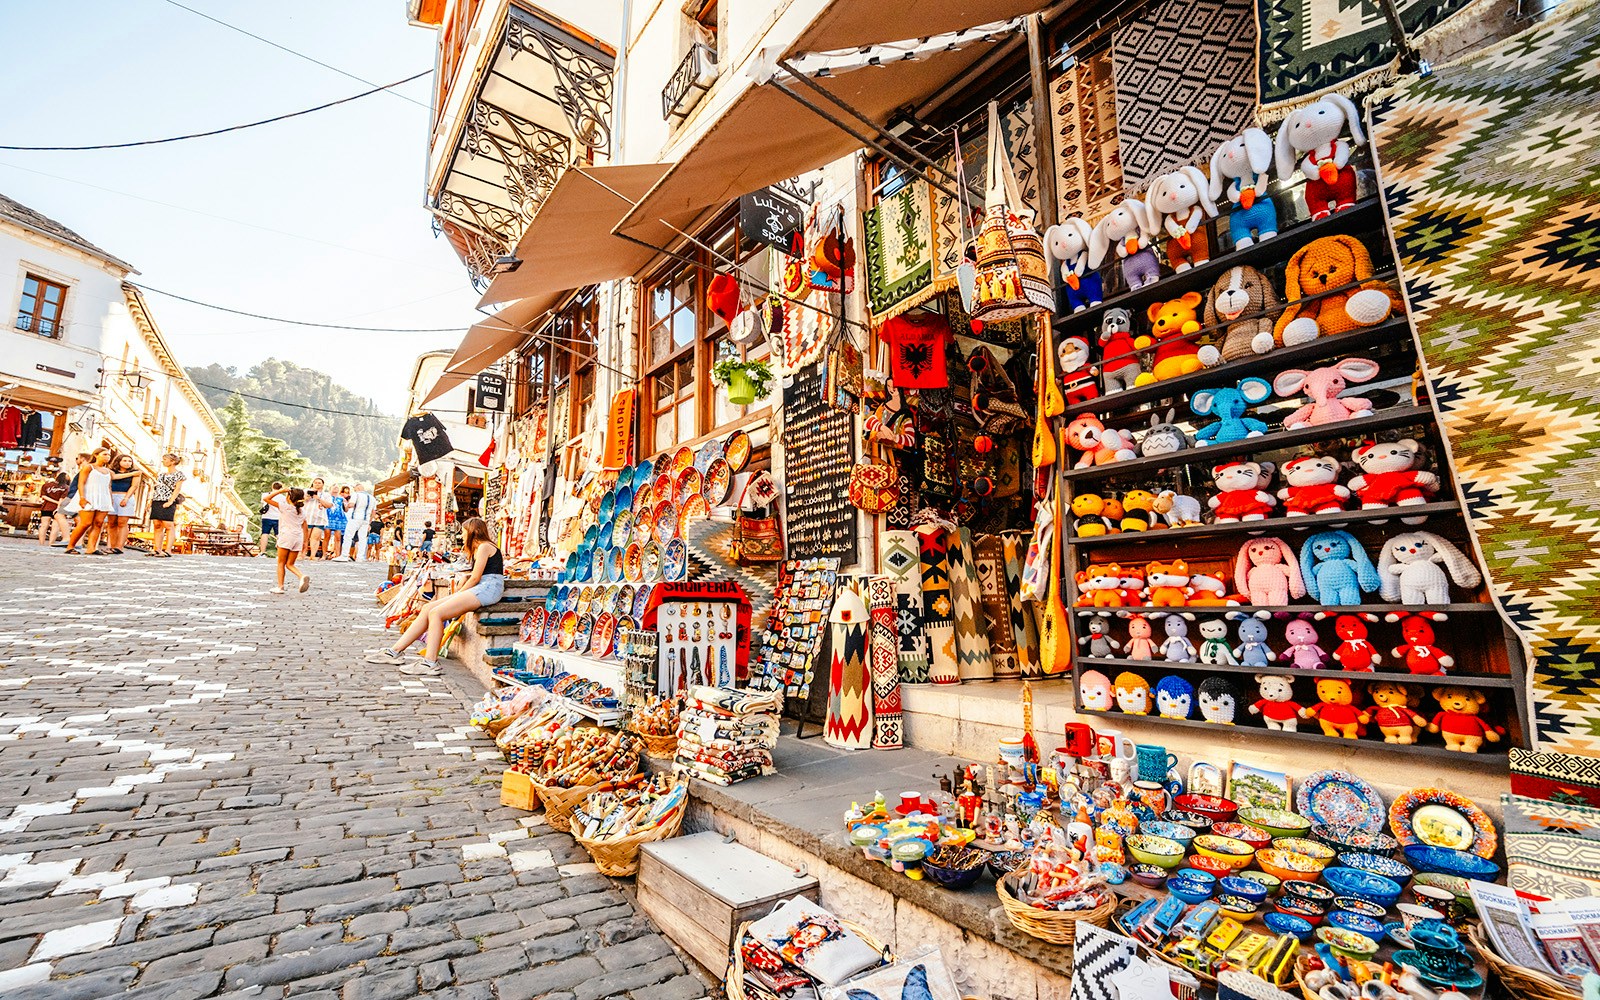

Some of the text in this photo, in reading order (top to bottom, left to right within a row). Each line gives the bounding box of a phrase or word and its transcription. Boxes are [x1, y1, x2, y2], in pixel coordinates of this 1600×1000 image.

[753, 196, 795, 223] LuLu's
[762, 229, 787, 246] spot
[482, 376, 502, 386] OLD
[480, 384, 503, 396] WELL
[1478, 893, 1517, 907] BOOKMARK
